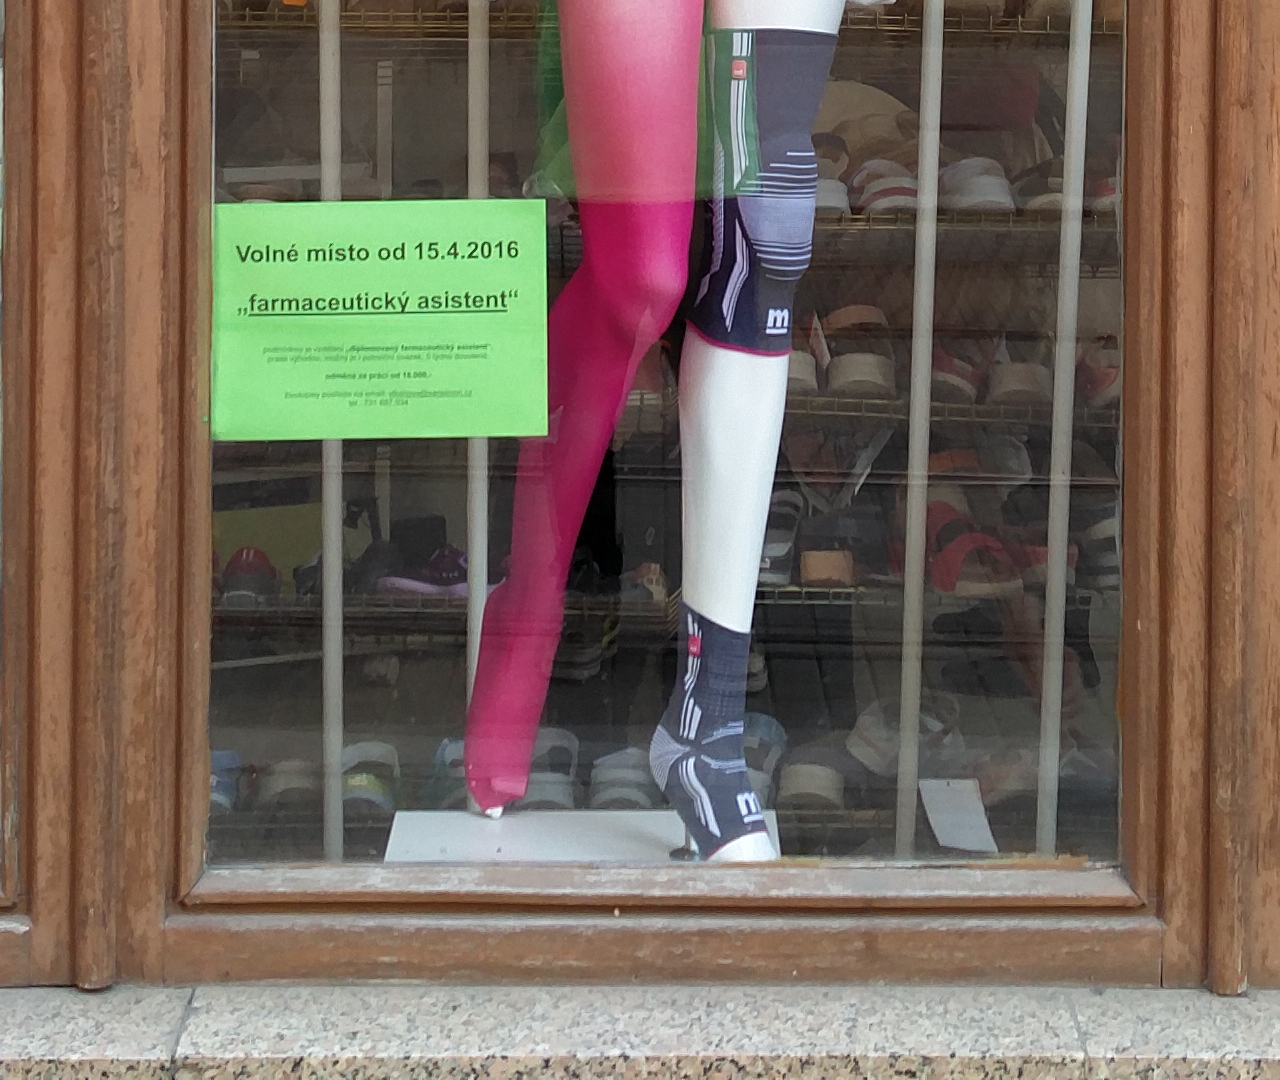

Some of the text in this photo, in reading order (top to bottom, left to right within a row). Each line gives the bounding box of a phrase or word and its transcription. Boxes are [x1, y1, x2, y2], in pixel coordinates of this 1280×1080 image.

[236, 240, 520, 263] Volné místo od 15.4.2016
